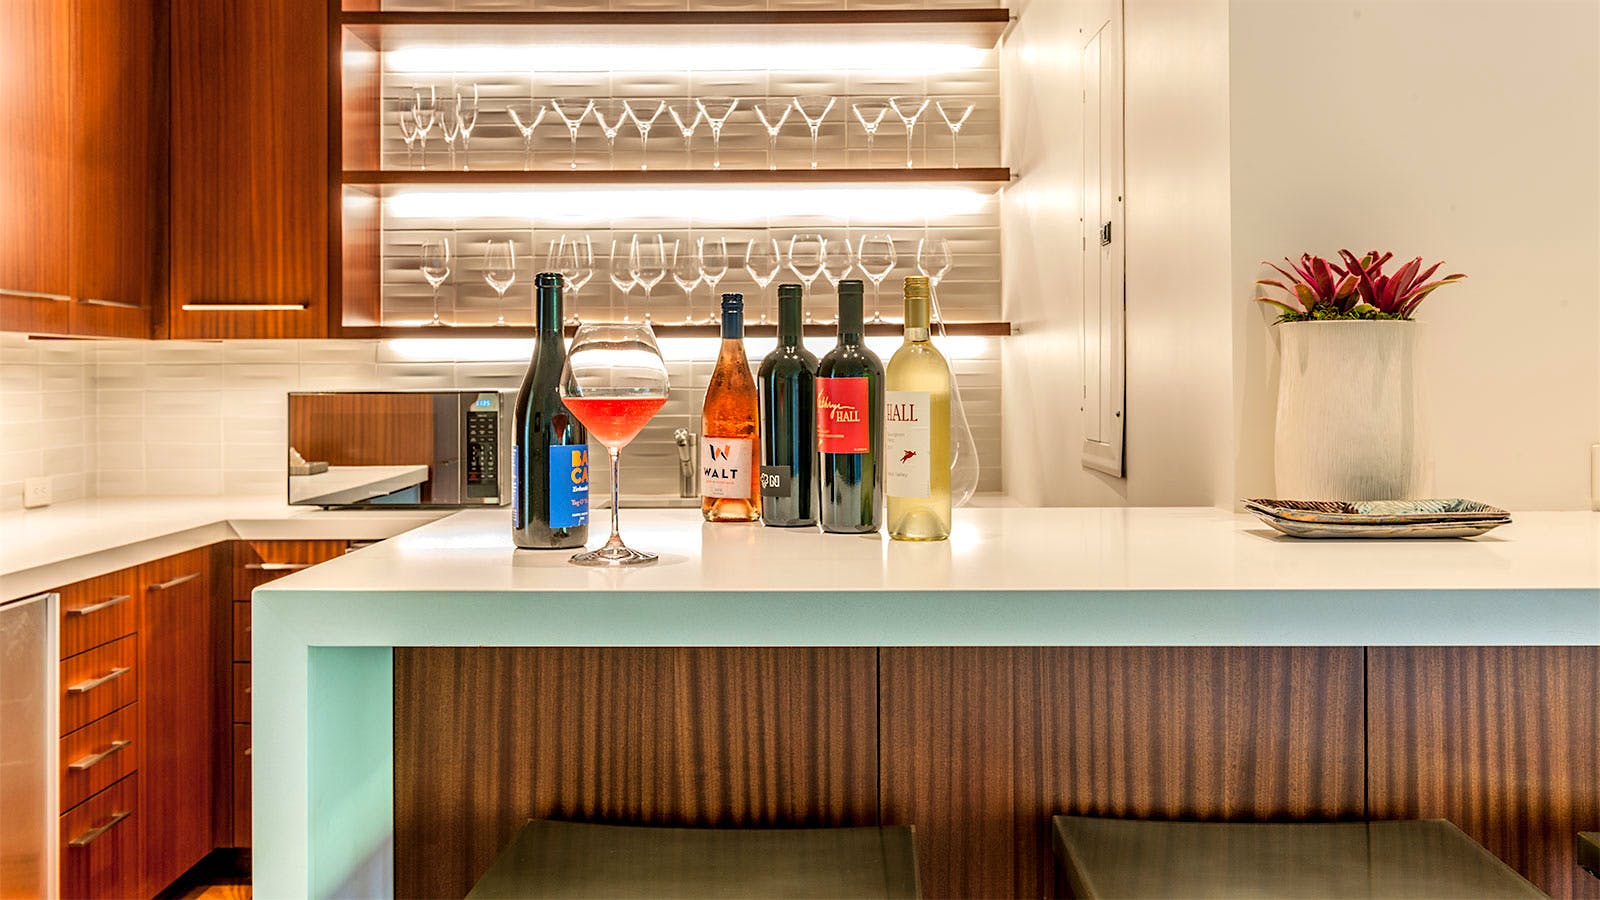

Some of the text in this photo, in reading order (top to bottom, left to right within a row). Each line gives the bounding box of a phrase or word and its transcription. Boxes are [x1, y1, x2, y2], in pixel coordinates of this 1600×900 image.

[836, 410, 861, 422] HALL
[887, 403, 918, 422] HALL
[571, 450, 588, 467] BA
[709, 443, 731, 461] W
[571, 467, 588, 484] CA
[703, 467, 738, 479] WALT
